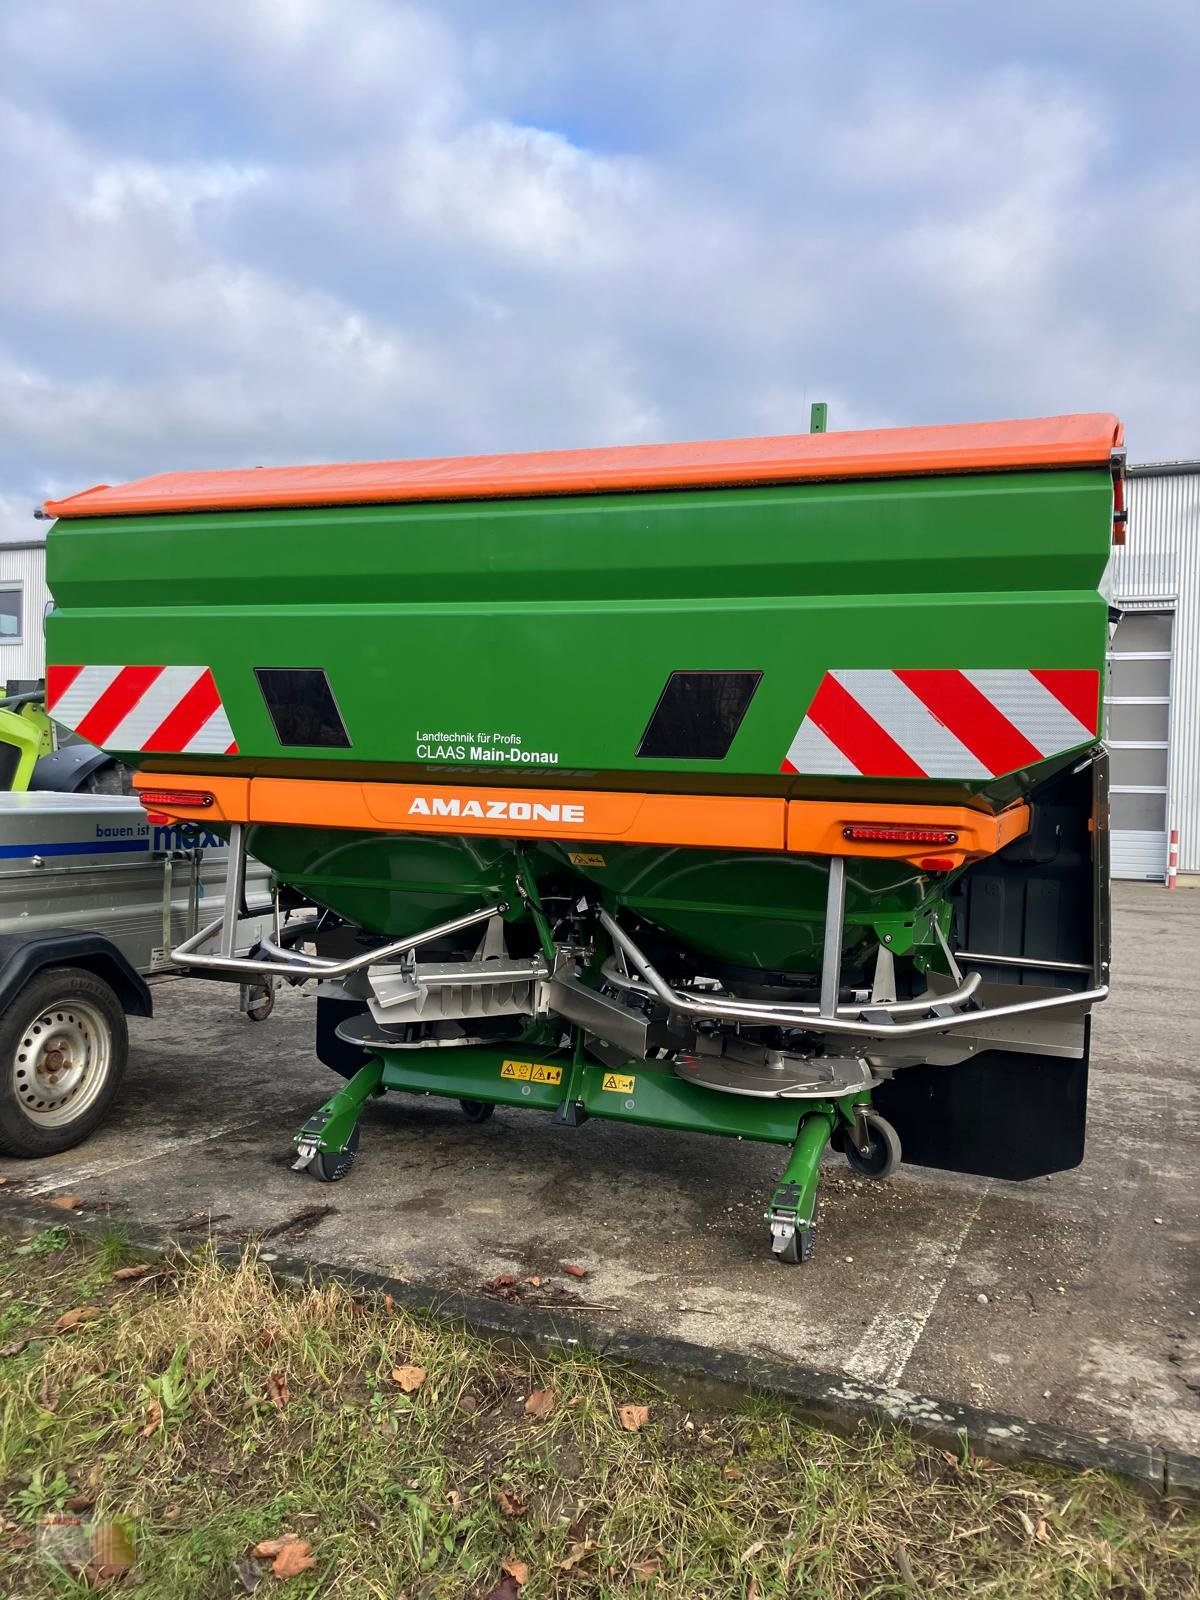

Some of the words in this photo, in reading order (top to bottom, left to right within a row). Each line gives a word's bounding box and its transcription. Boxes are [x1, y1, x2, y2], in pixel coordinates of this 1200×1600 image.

[416, 731, 475, 743] Landtechnik
[477, 733, 490, 744] für
[493, 733, 522, 745] Profis
[416, 745, 466, 760] CLAAS
[470, 747, 559, 763] Main-Donau
[408, 797, 585, 823] AMAZONE
[96, 823, 134, 838] bauen
[137, 823, 150, 836] ist
